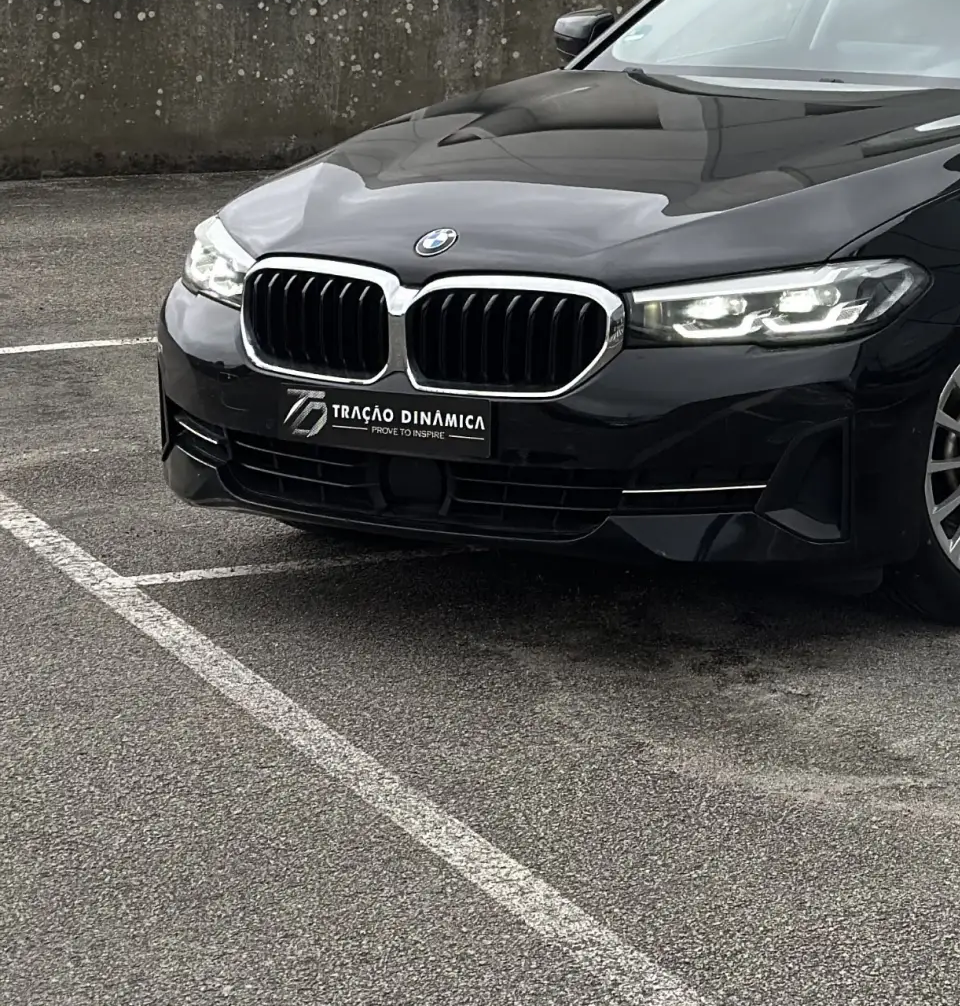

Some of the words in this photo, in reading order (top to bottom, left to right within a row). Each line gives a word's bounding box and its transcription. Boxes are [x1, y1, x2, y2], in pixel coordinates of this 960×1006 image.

[332, 404, 394, 424] TRAÇÃO
[401, 410, 486, 430] DINÂMICA
[371, 426, 398, 436] PROVE
[400, 428, 411, 437] TO
[413, 429, 445, 439] INSPIRE
